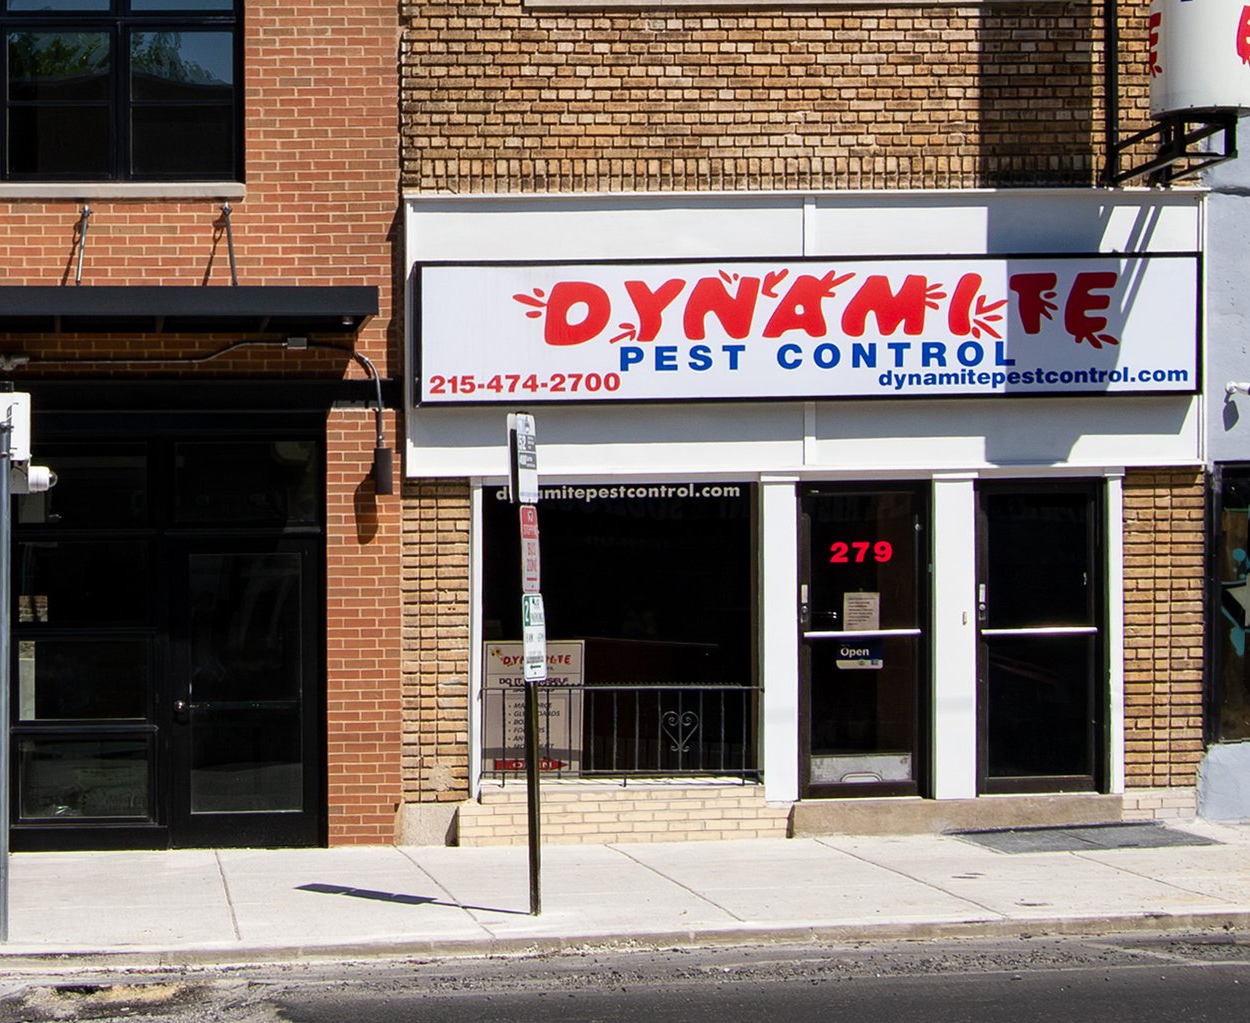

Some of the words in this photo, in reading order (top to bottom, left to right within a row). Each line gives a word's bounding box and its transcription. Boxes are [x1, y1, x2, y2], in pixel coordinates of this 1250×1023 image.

[513, 269, 1119, 349] DYNAMITE
[619, 344, 746, 372] PEST
[776, 339, 1016, 370] CONTROL
[429, 372, 621, 394] 215-474-2700
[878, 366, 1189, 391] dynamitepestcontrol.com
[830, 541, 893, 563] 279
[840, 647, 870, 658] Open
